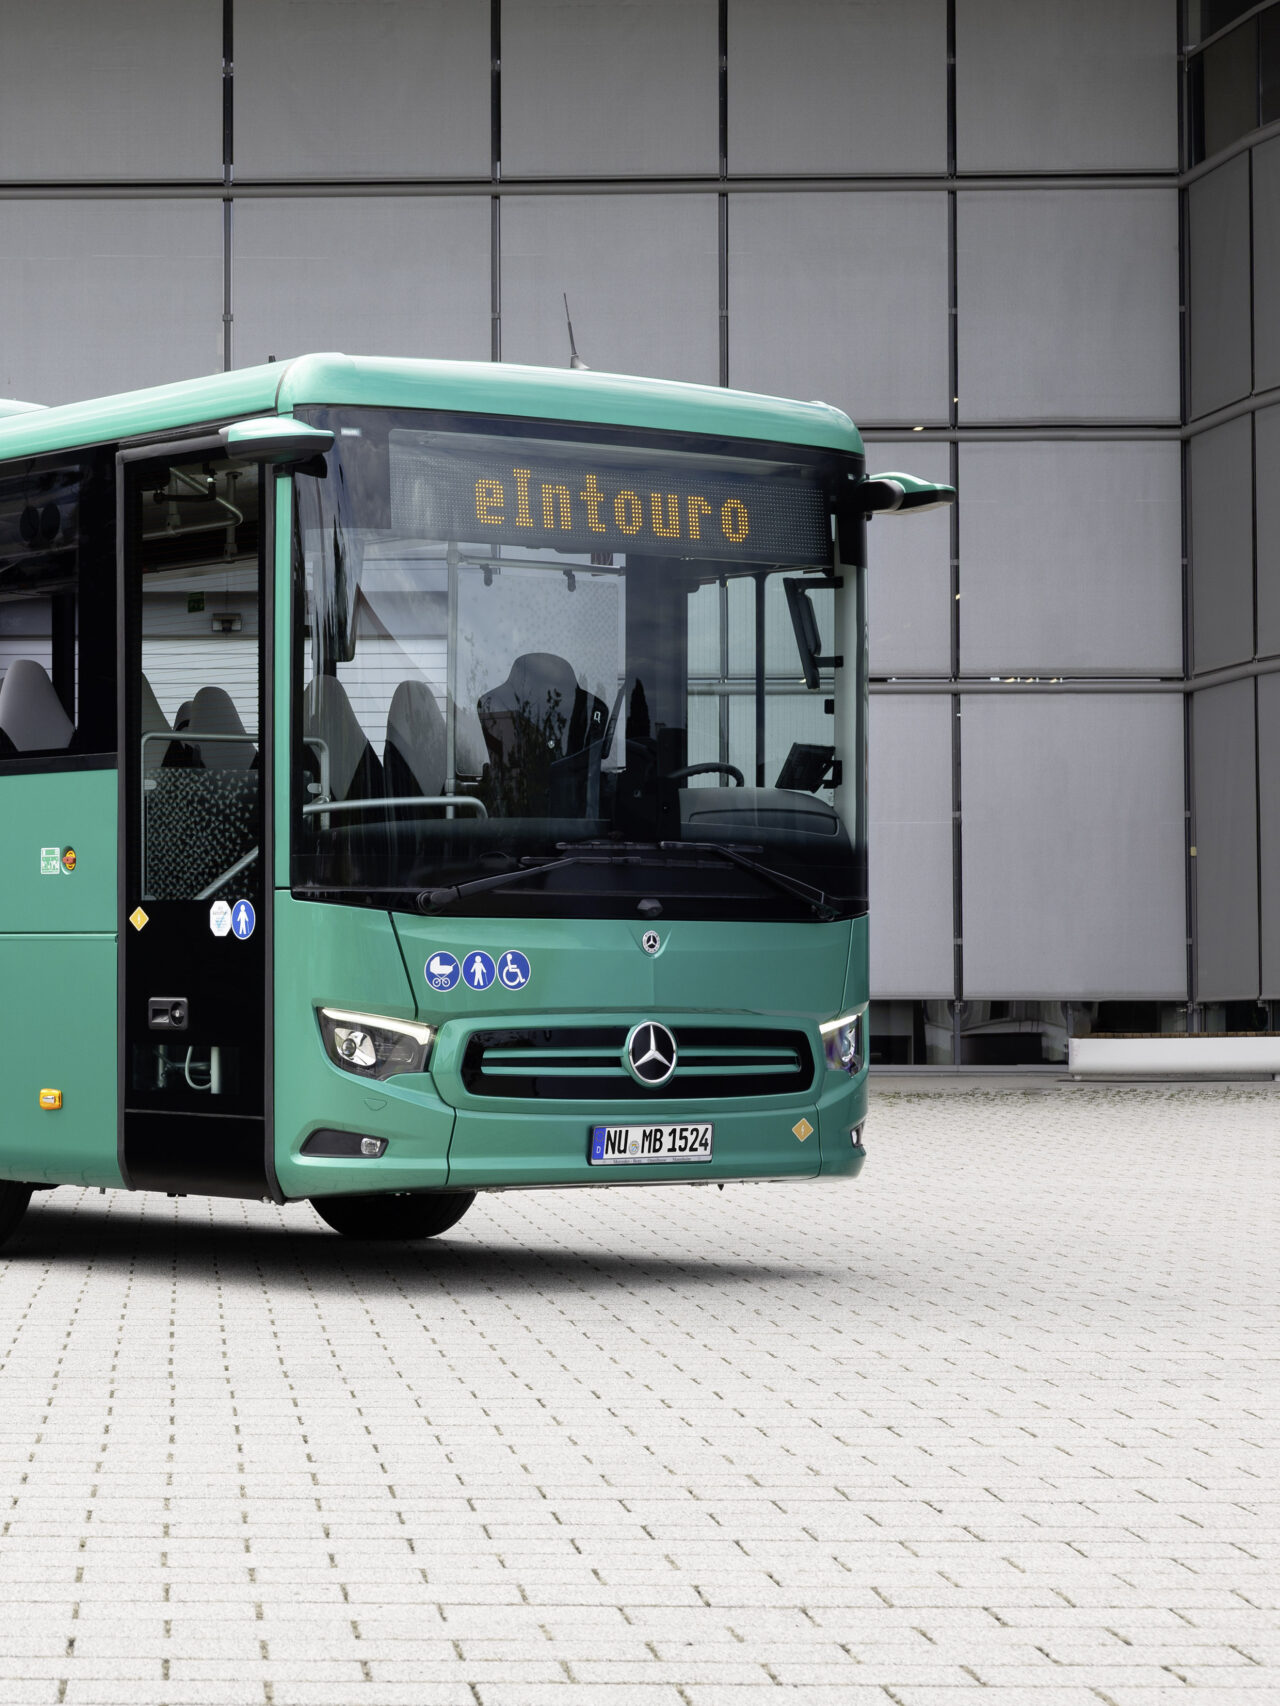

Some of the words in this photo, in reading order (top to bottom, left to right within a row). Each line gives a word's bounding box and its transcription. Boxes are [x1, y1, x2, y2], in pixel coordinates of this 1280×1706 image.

[475, 468, 749, 542] eIntouro
[596, 1146, 601, 1154] D
[605, 1129, 629, 1155] NU
[641, 1128, 664, 1154] MB
[667, 1127, 709, 1152] 1524
